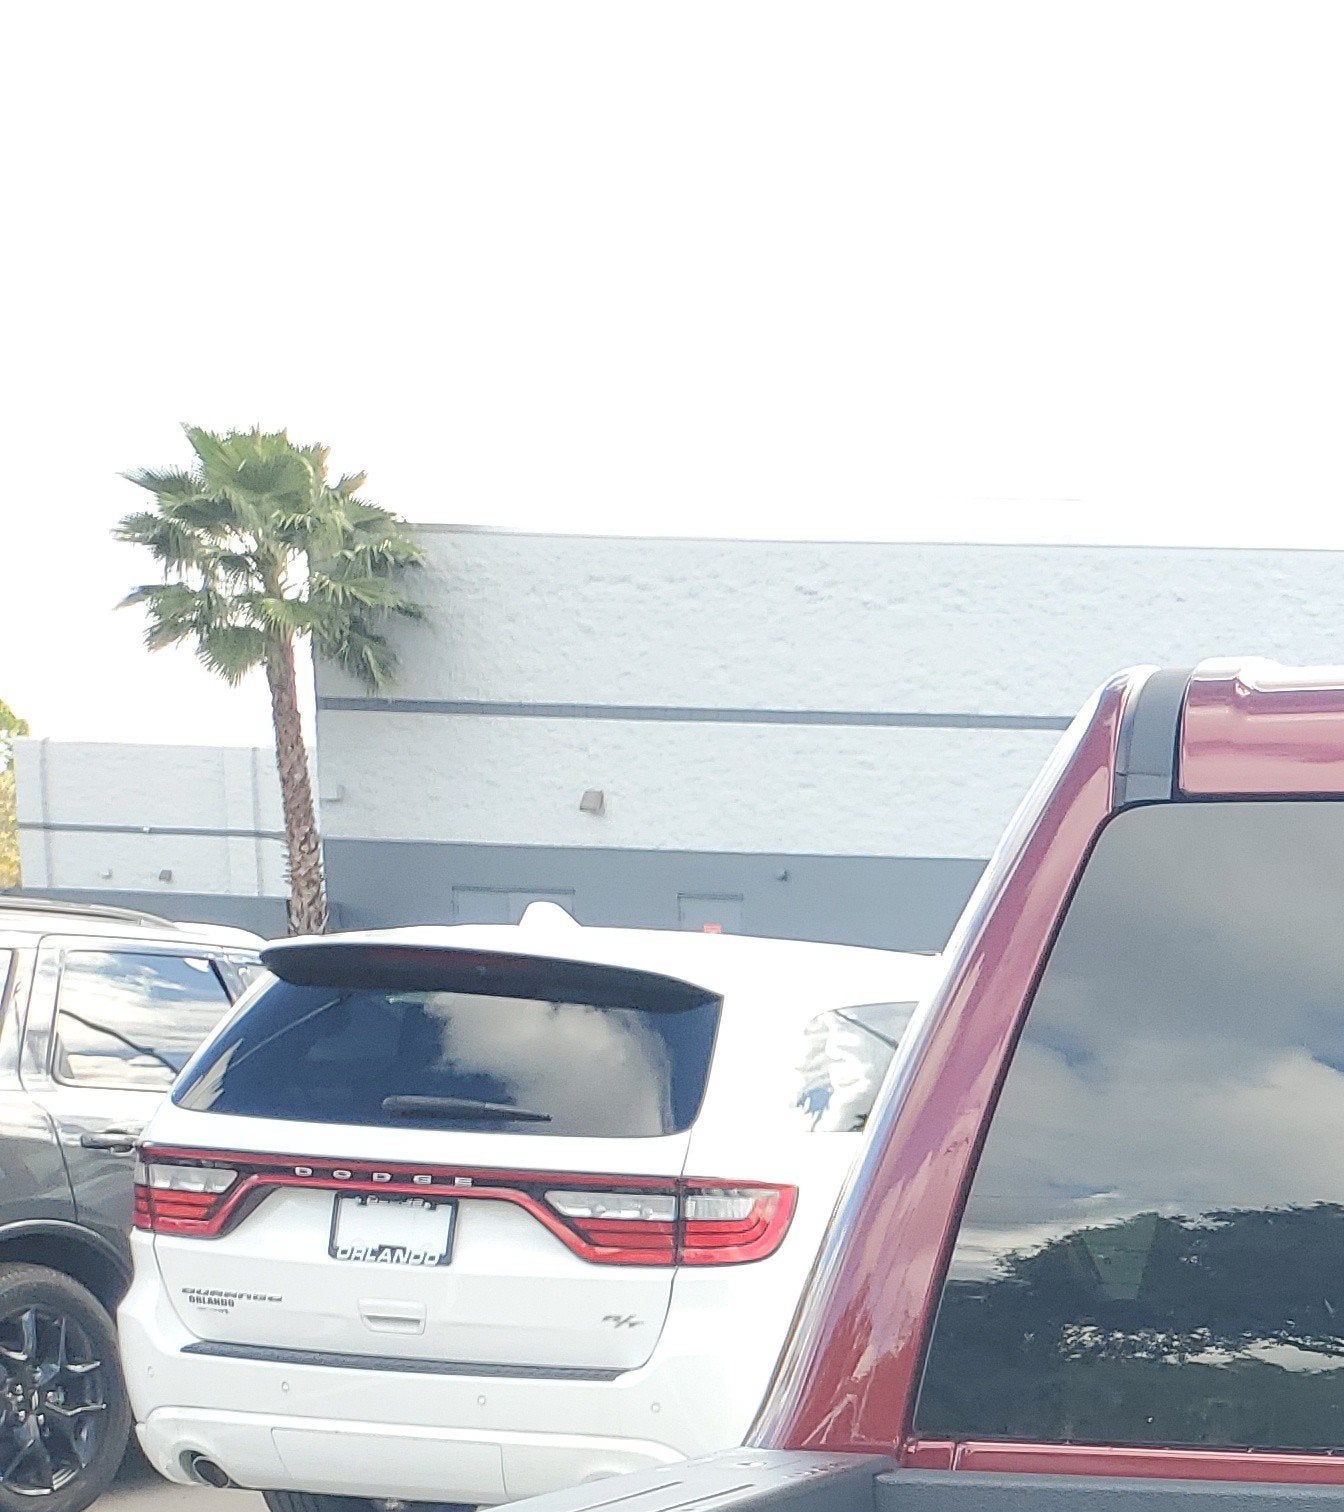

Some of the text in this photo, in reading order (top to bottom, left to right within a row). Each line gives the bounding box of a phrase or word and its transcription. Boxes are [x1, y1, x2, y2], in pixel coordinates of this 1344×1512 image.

[294, 1166, 473, 1186] DODGE
[336, 1246, 441, 1267] ORLANDO
[188, 1295, 235, 1307] ORLANDO
